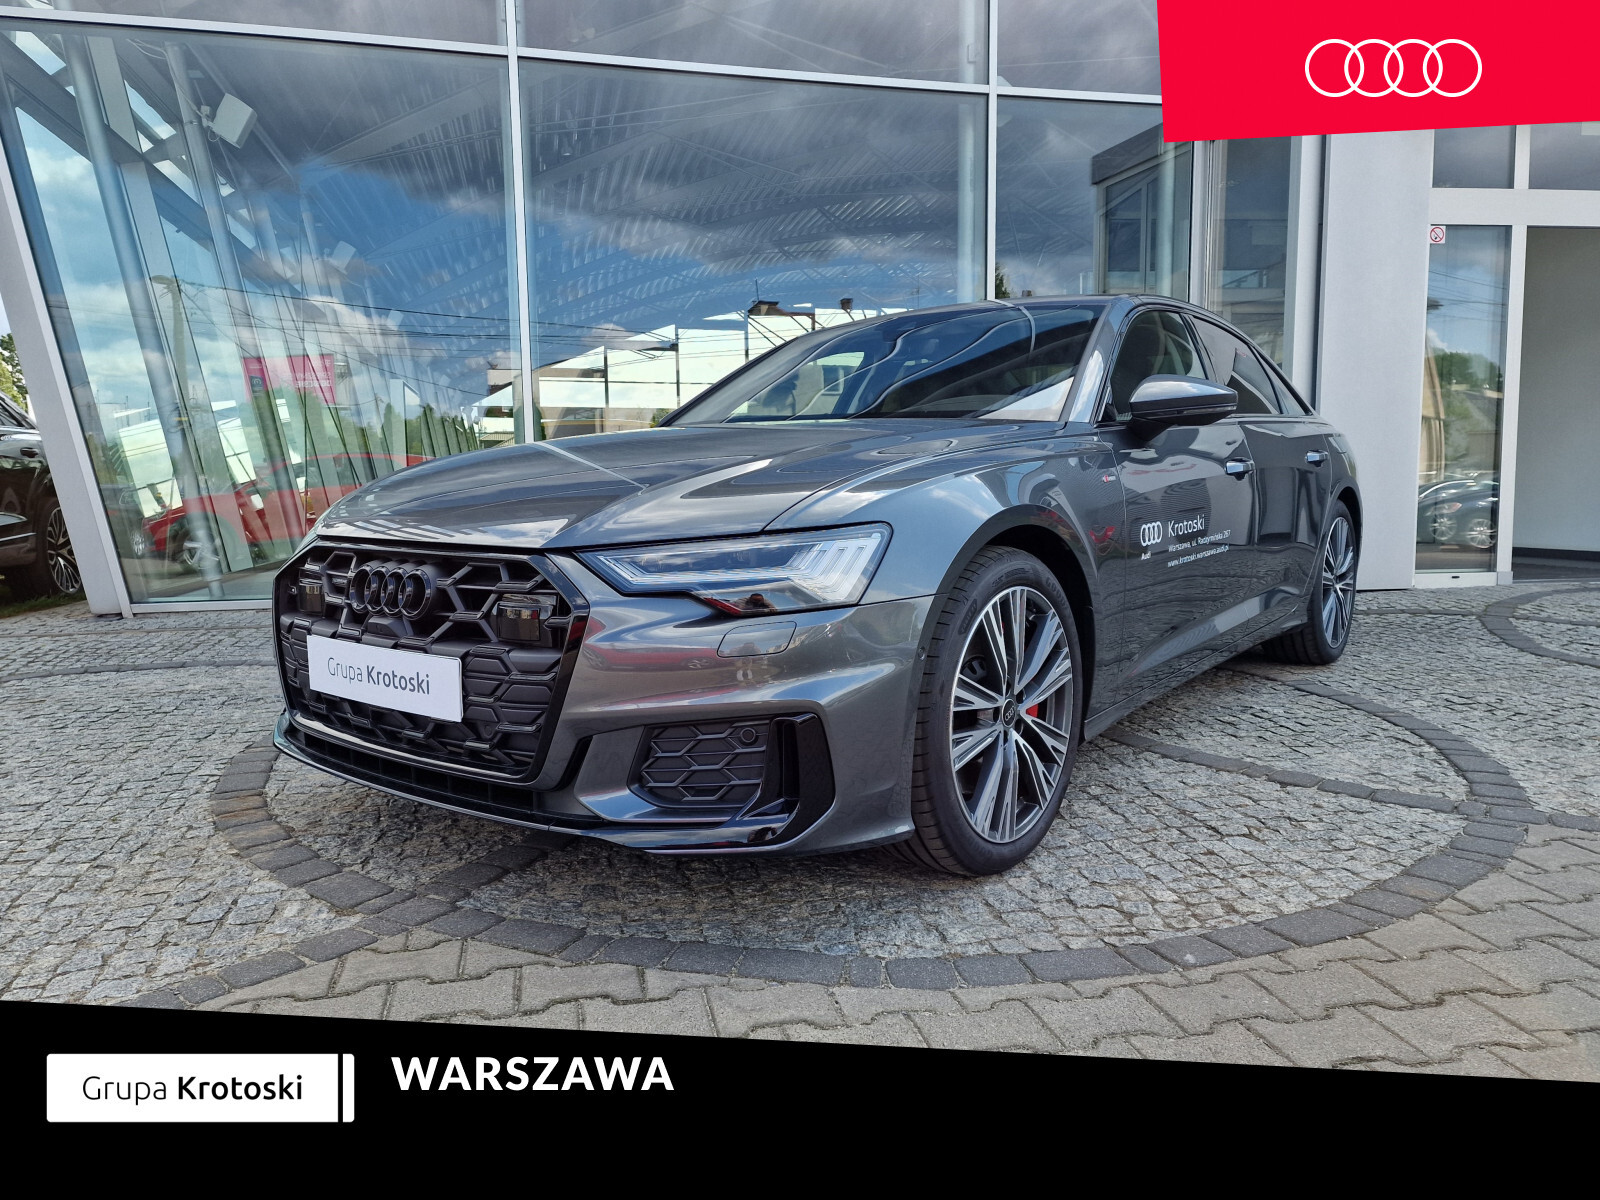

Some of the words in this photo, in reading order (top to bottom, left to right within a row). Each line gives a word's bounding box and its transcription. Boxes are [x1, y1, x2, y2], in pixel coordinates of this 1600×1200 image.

[1168, 514, 1205, 537] Krotoski
[1141, 550, 1152, 560] Audi
[327, 657, 363, 684] Grupa
[366, 665, 430, 695] Krotoski
